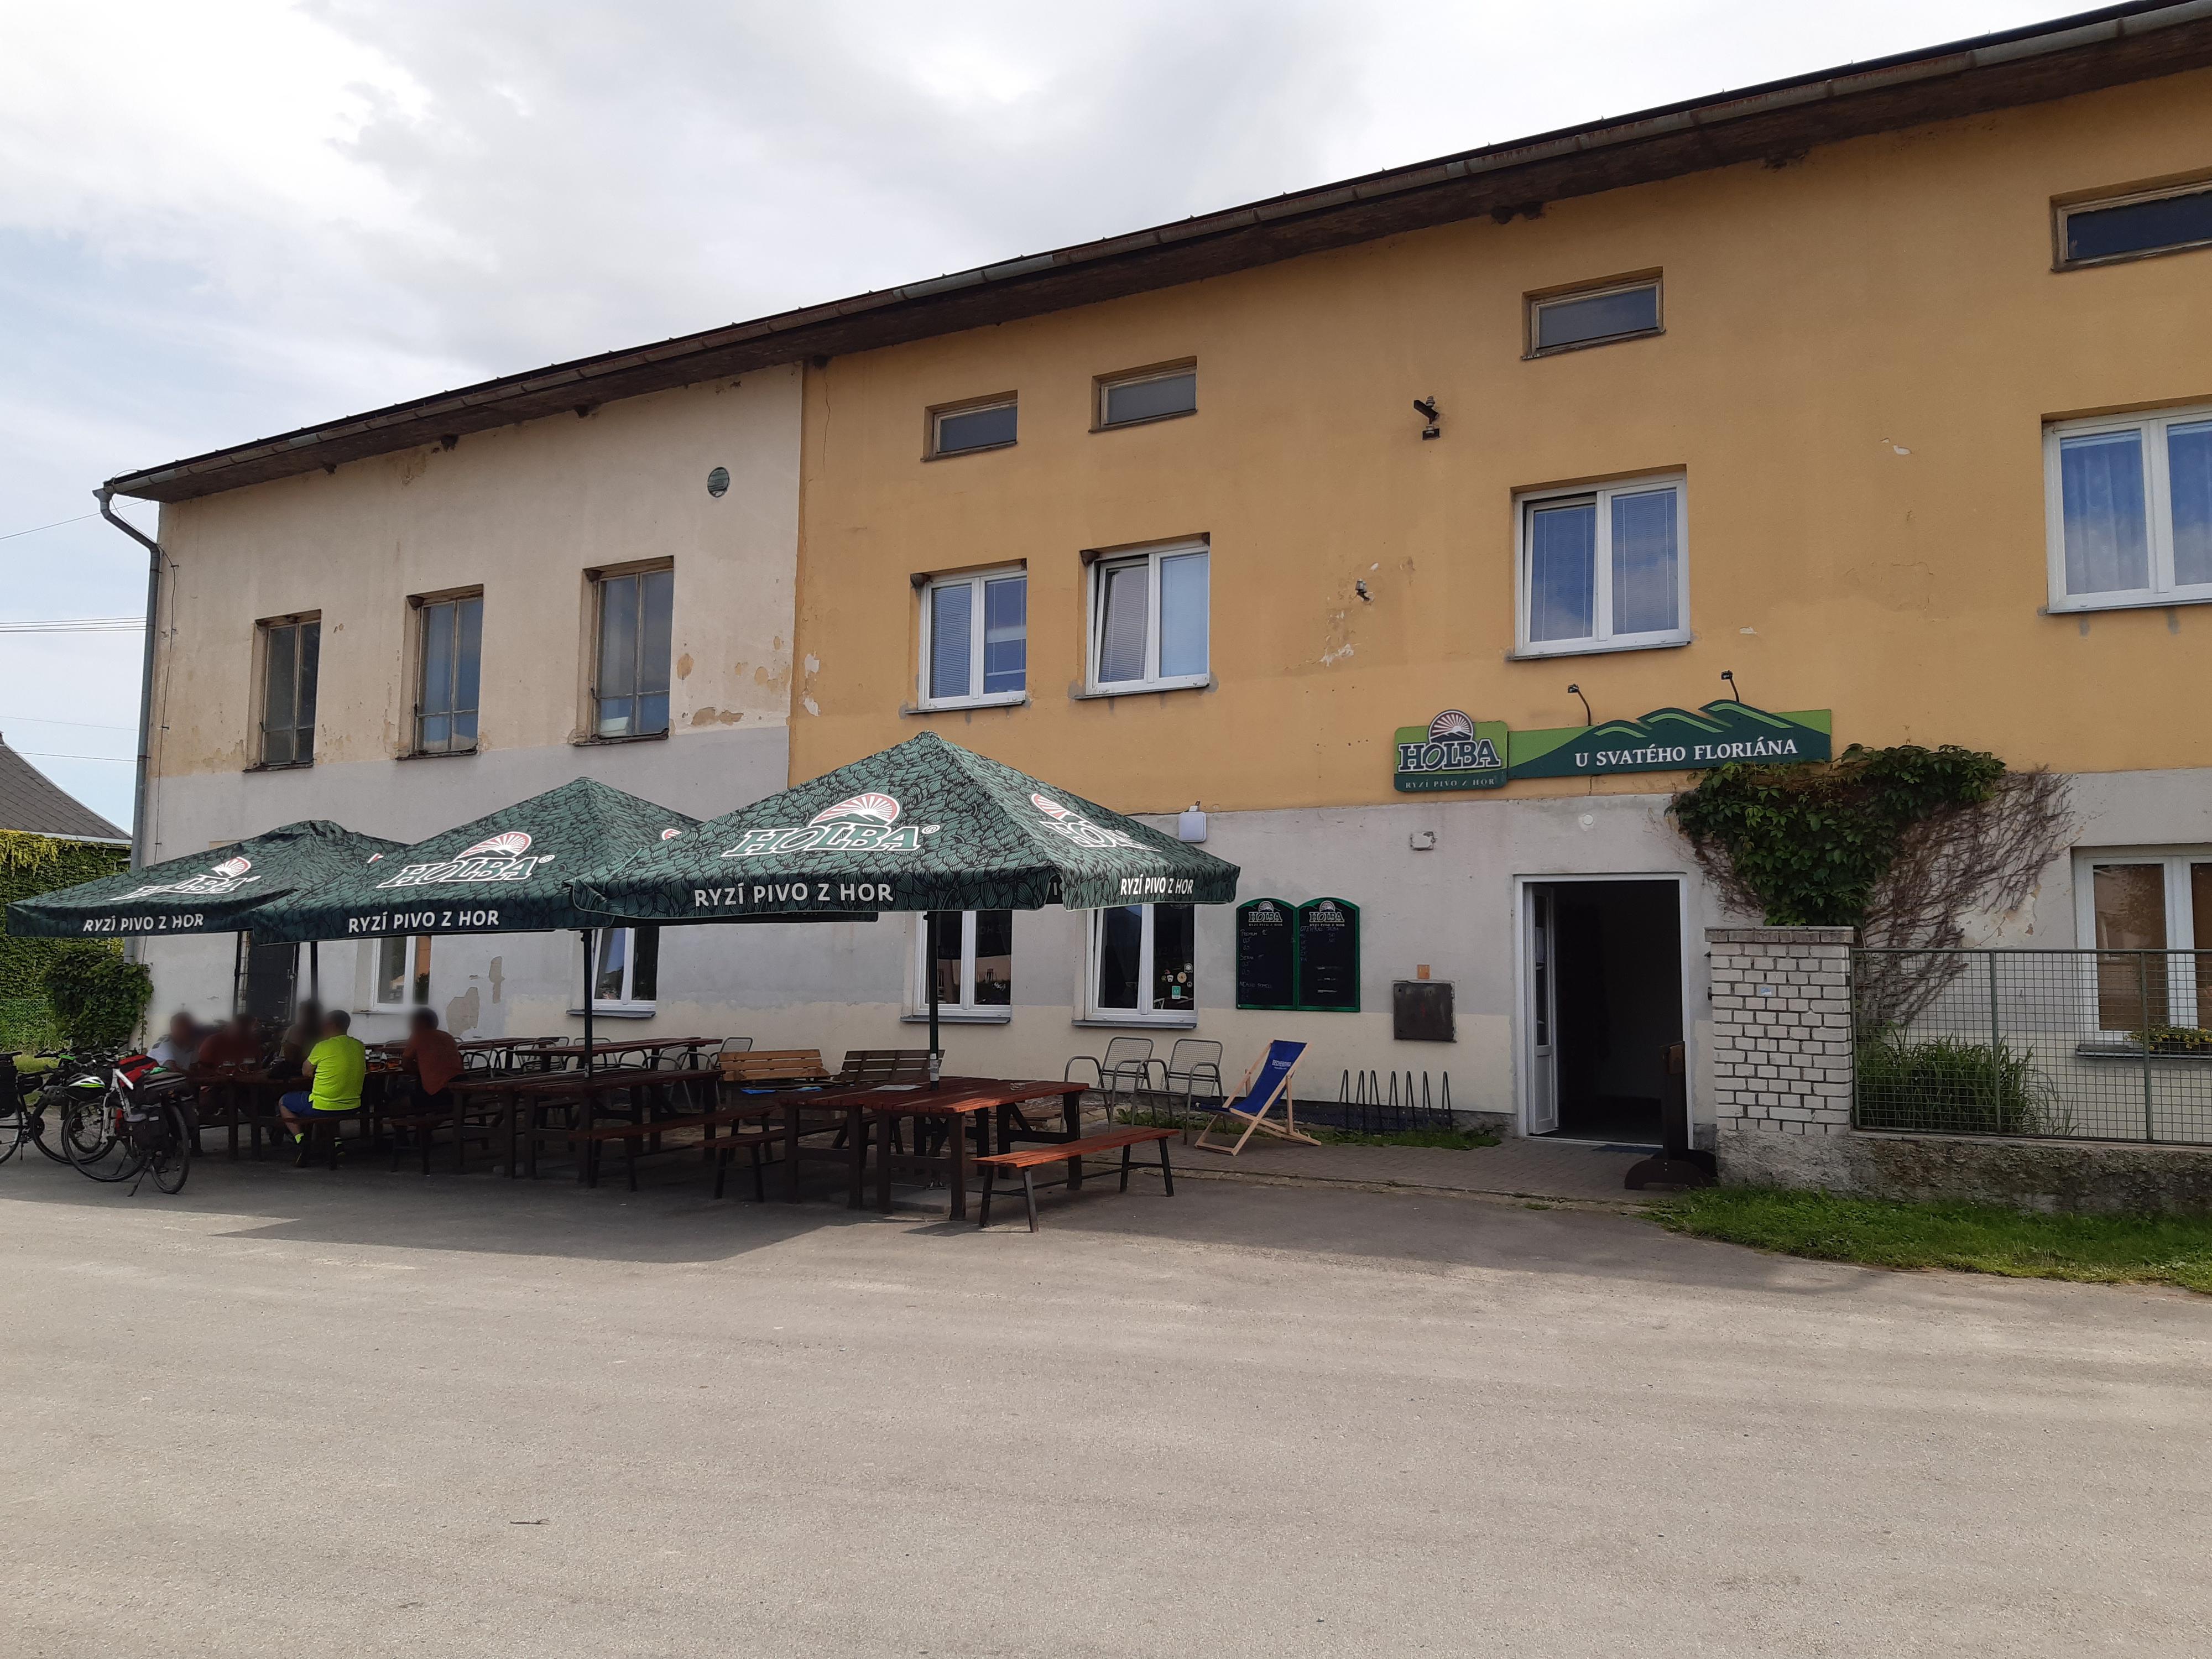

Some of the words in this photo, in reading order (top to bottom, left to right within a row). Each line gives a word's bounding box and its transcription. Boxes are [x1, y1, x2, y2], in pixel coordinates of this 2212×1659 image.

[1398, 739, 1501, 772] HOLBA
[1575, 753, 1588, 767] U
[1596, 744, 1686, 766] SVATÉHO
[1693, 737, 1798, 760] FLORIÁNA
[721, 823, 922, 858] HOLBA
[377, 857, 536, 888] HOLBA
[695, 883, 744, 907] RYZÍ
[754, 883, 808, 903] PIVO
[818, 884, 830, 901] Z
[841, 883, 894, 901] HOR
[1120, 874, 1143, 895] RYZÍ
[1145, 877, 1165, 894] PIVO
[1168, 879, 1173, 894] Z
[1175, 878, 1194, 894] HOR
[83, 915, 116, 932] RYZÍ
[121, 915, 154, 931] PIVO
[159, 915, 166, 930] Z
[172, 914, 204, 928] HOR
[348, 911, 388, 933] RYZÍ
[393, 910, 435, 928] PIVO
[442, 911, 451, 926] Z
[459, 910, 499, 926] HOR
[1248, 911, 1282, 922] HOLBA
[1309, 911, 1345, 923] HOLBA
